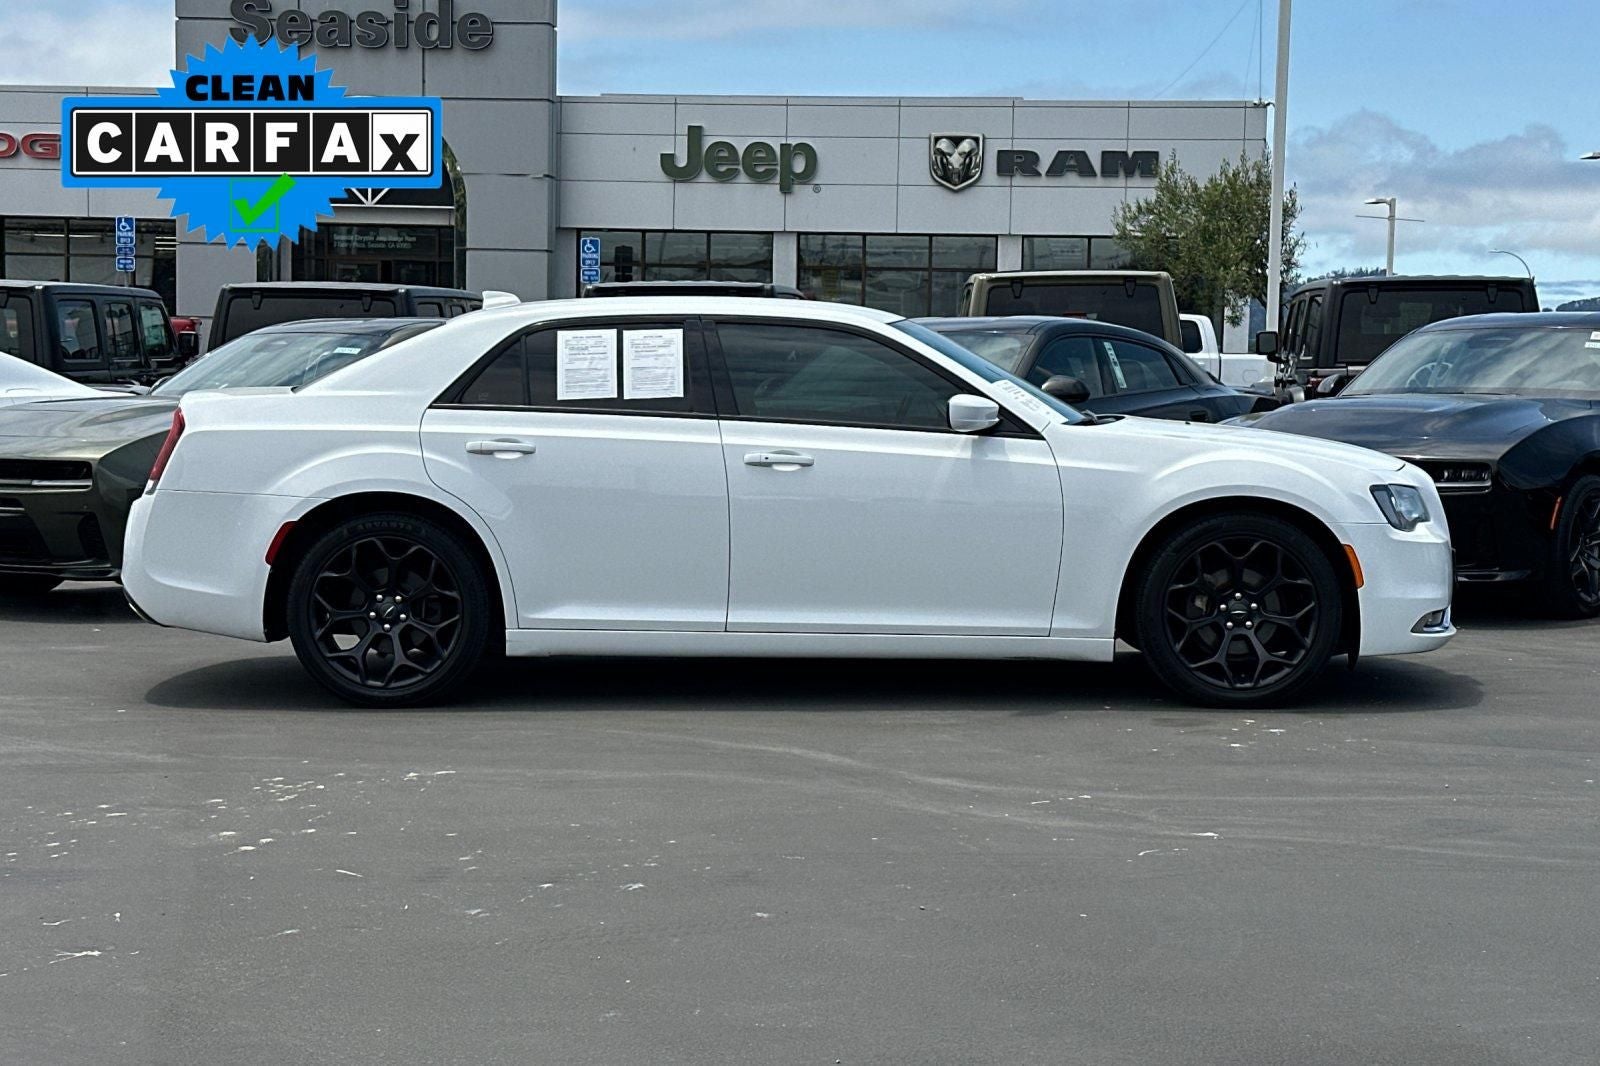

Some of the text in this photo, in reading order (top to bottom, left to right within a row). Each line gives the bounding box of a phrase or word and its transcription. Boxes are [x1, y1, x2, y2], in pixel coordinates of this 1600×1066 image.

[229, 0, 494, 49] Seaside
[660, 125, 818, 193] Jeep
[997, 149, 1159, 177] RAM
